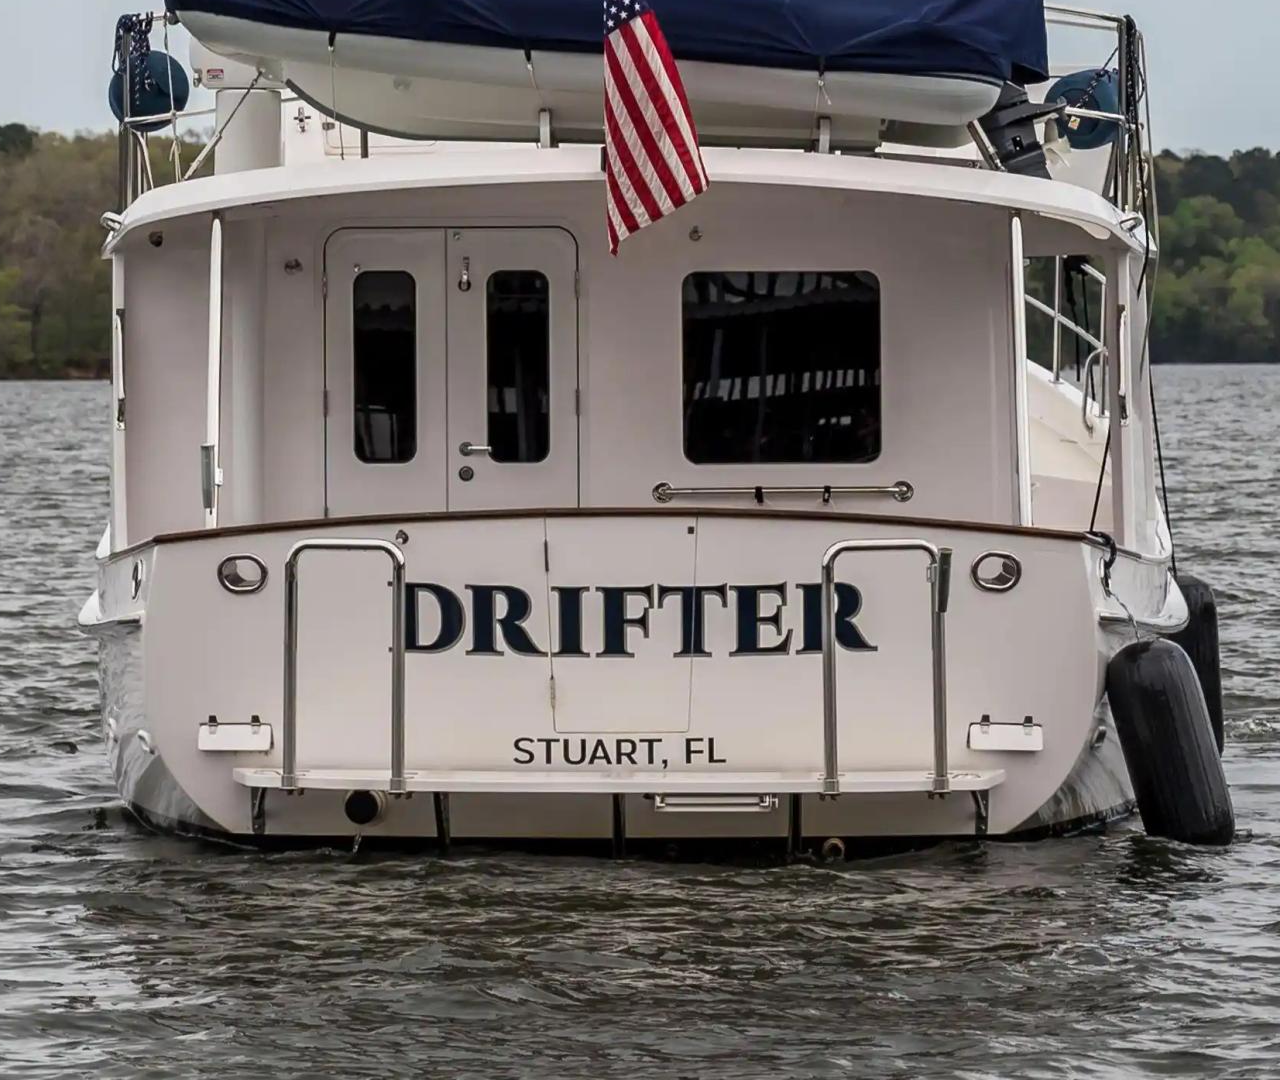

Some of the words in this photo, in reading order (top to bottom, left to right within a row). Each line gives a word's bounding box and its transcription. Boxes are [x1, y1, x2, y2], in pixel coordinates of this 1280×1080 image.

[387, 580, 878, 657] DRIFTER
[513, 737, 668, 769] STUART,
[685, 737, 727, 764] FL
